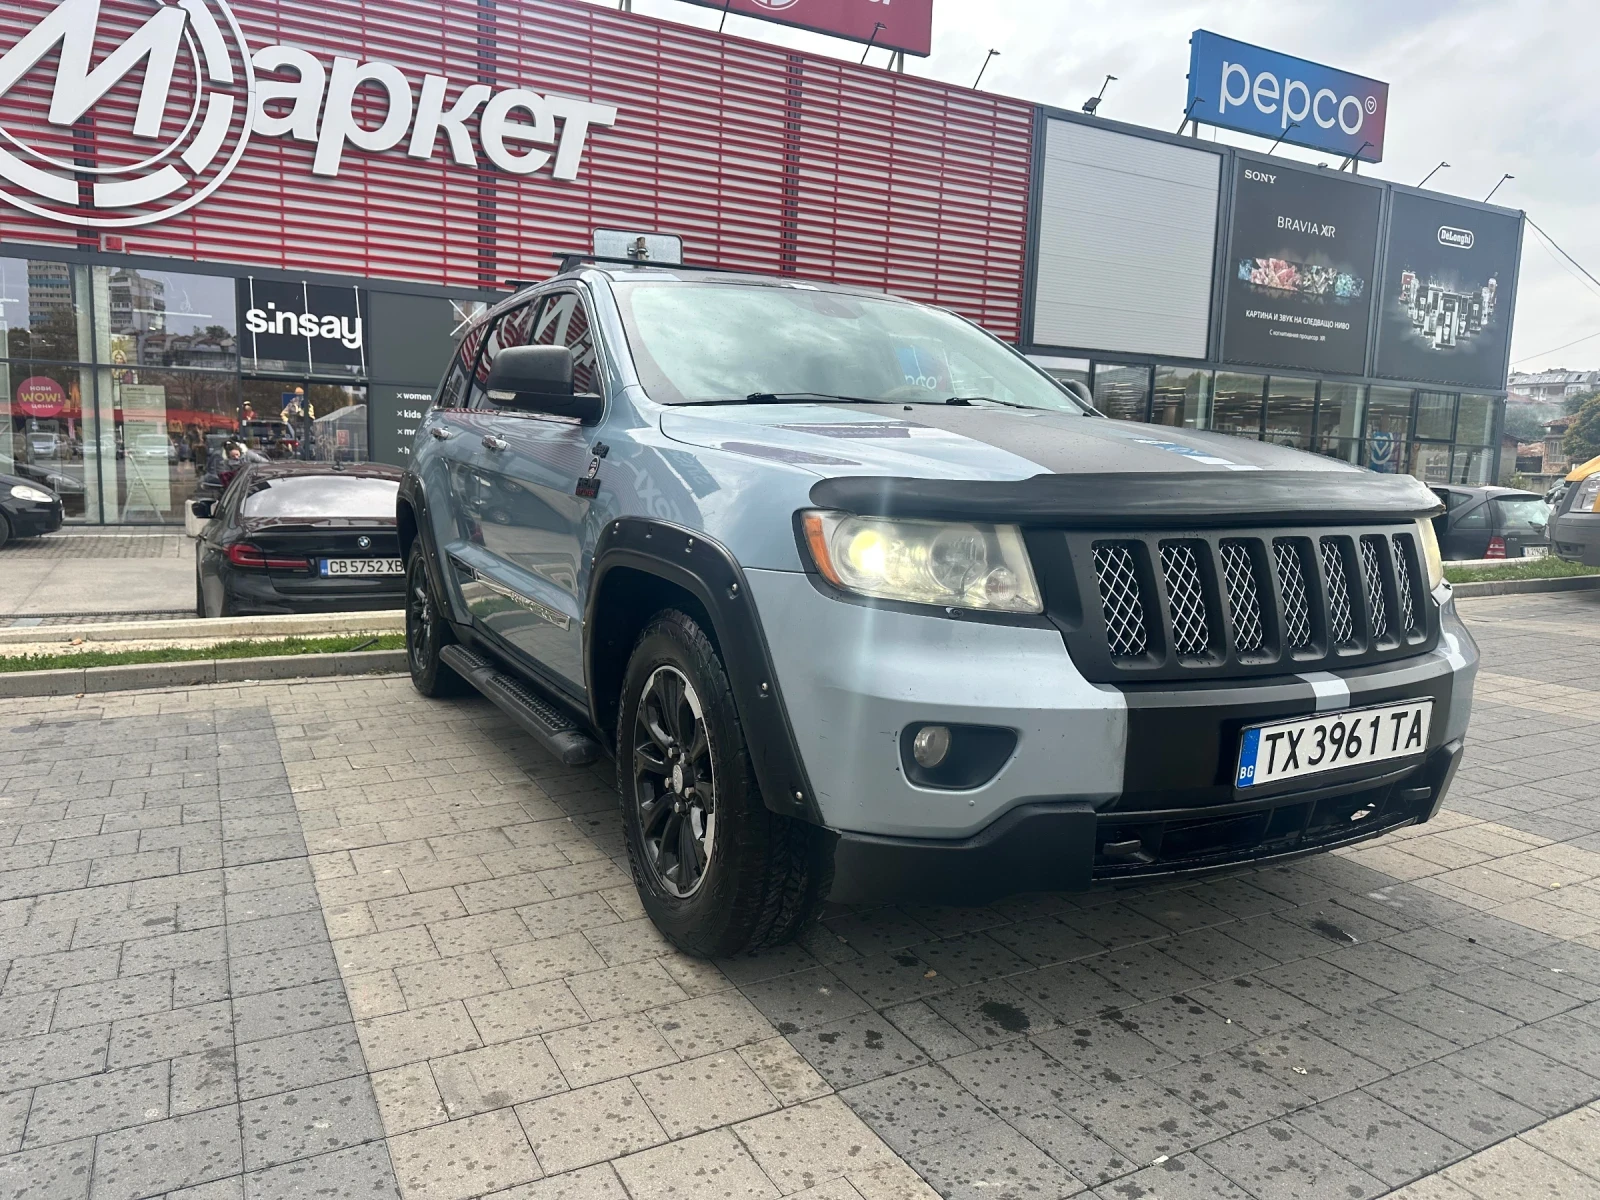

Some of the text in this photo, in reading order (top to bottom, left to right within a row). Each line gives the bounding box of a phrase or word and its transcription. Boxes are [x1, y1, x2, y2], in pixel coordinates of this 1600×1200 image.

[1219, 61, 1364, 135] pepco
[1244, 169, 1277, 184] SONY
[1277, 216, 1319, 235] BRAVIA
[245, 302, 362, 349] sinsay
[1245, 309, 1350, 330] КАРТИНА И ЗВУК НА СЛЕДВАЩО НИВО
[21, 392, 62, 402] WOW!
[403, 393, 432, 401] women
[404, 409, 422, 419] kids
[330, 560, 404, 573] CB 5752 XB
[1265, 709, 1422, 775] TX 3961 TA
[1239, 765, 1254, 779] BG
